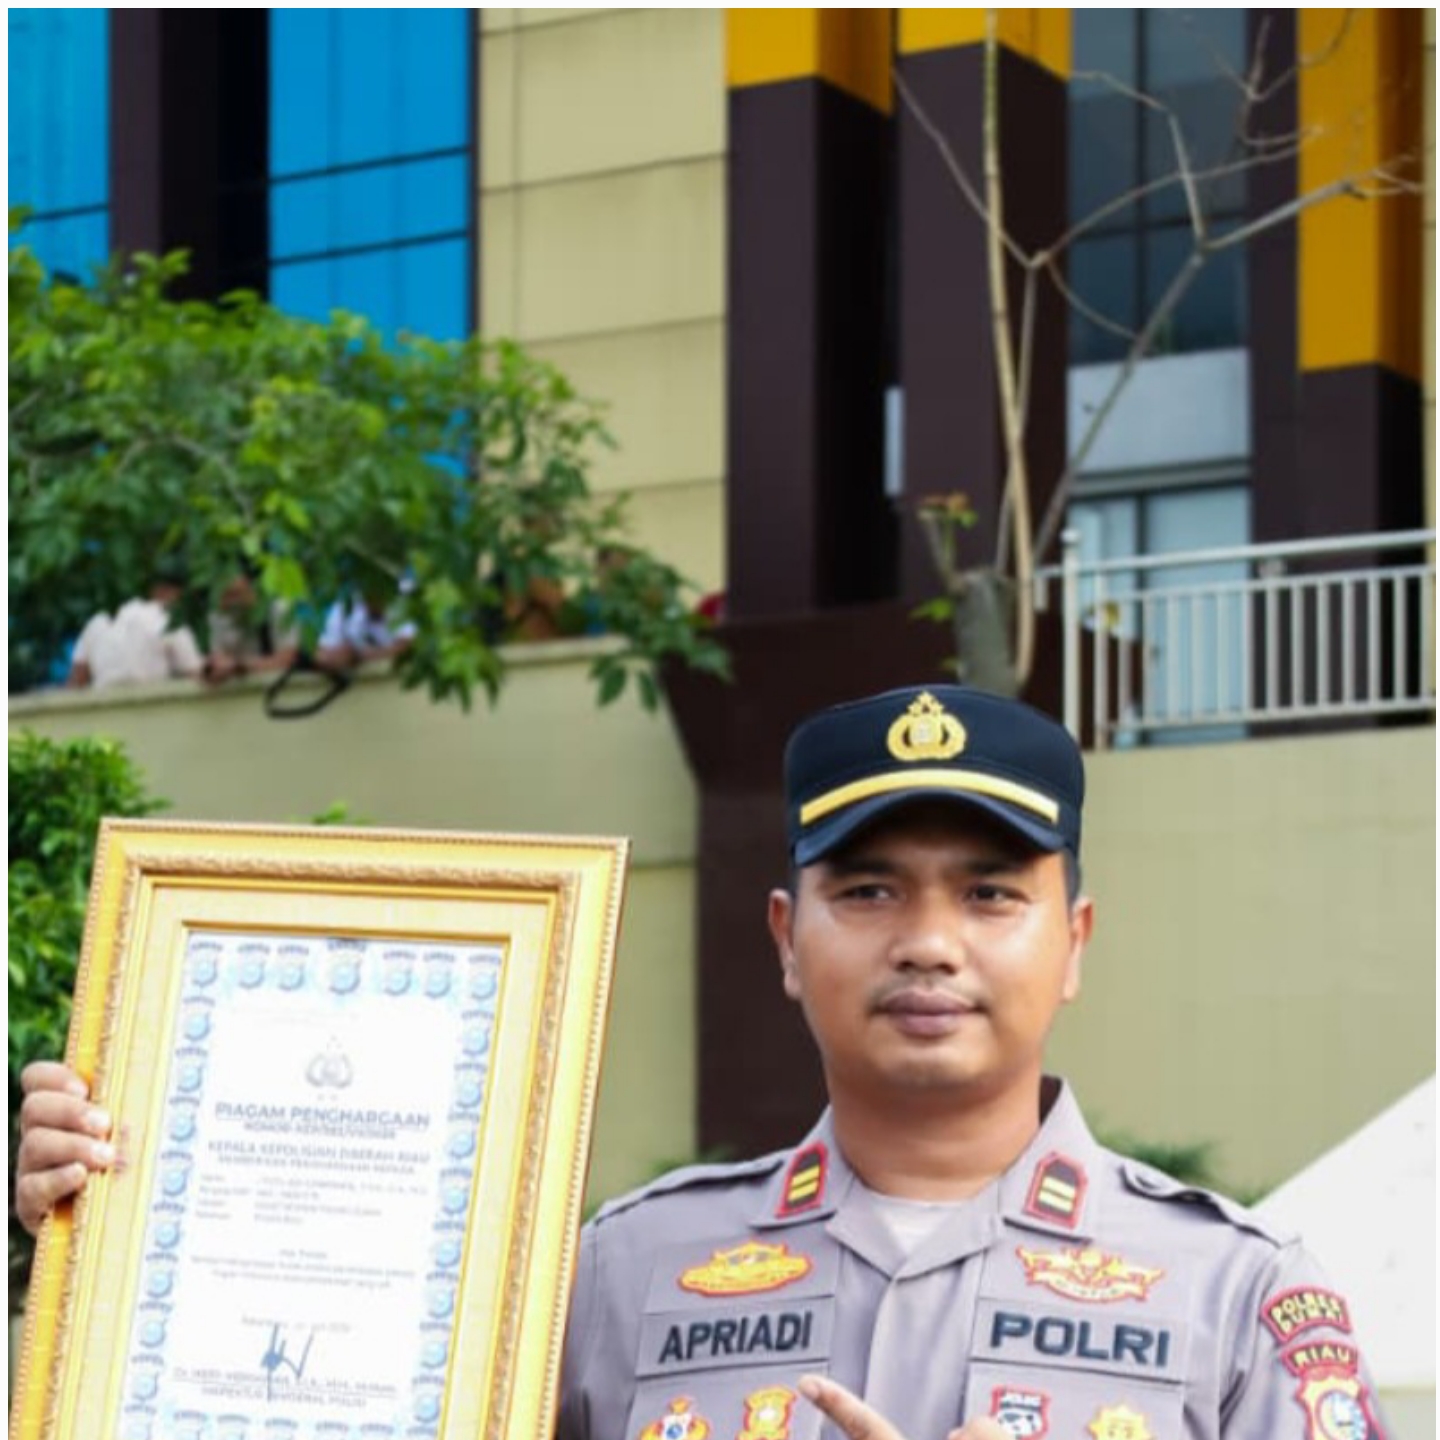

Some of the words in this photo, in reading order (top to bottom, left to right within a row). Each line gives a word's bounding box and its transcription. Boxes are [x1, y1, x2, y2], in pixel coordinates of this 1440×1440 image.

[214, 1101, 286, 1120] PIAGAM
[657, 1309, 814, 1365] APRIADI
[989, 1310, 1171, 1369] POLRI
[1294, 1343, 1350, 1368] RIAU
